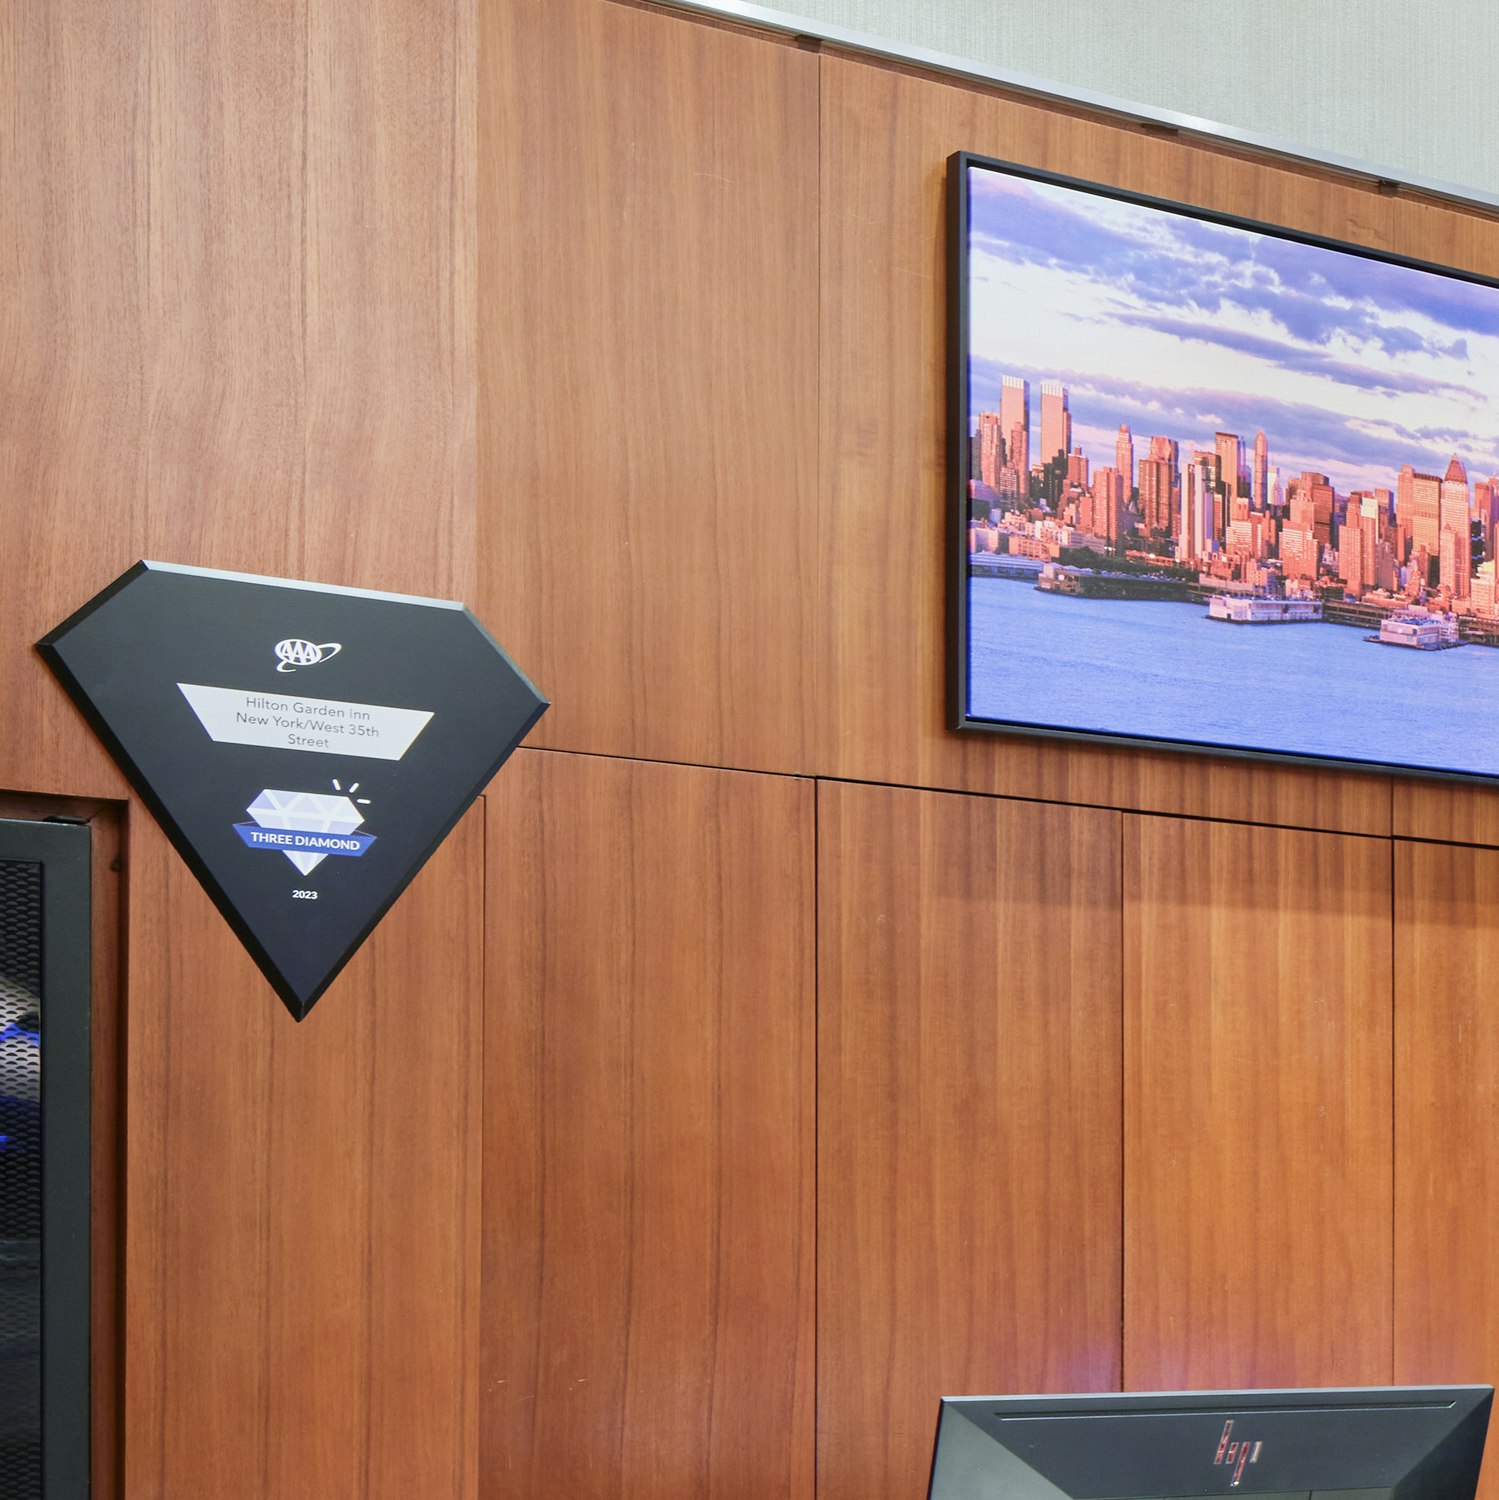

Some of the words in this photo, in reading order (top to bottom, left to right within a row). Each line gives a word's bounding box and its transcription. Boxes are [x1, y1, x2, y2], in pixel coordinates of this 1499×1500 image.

[279, 640, 319, 662] AAA
[246, 696, 289, 712] Hilton
[292, 702, 345, 719] Garden
[348, 708, 371, 721] Inn
[236, 712, 269, 726] New
[273, 715, 344, 734] York/West
[348, 724, 380, 738] 35th
[287, 733, 330, 749] Street
[250, 831, 293, 846] THREE
[295, 835, 361, 851] DIAMOND
[292, 889, 318, 900] 2023
